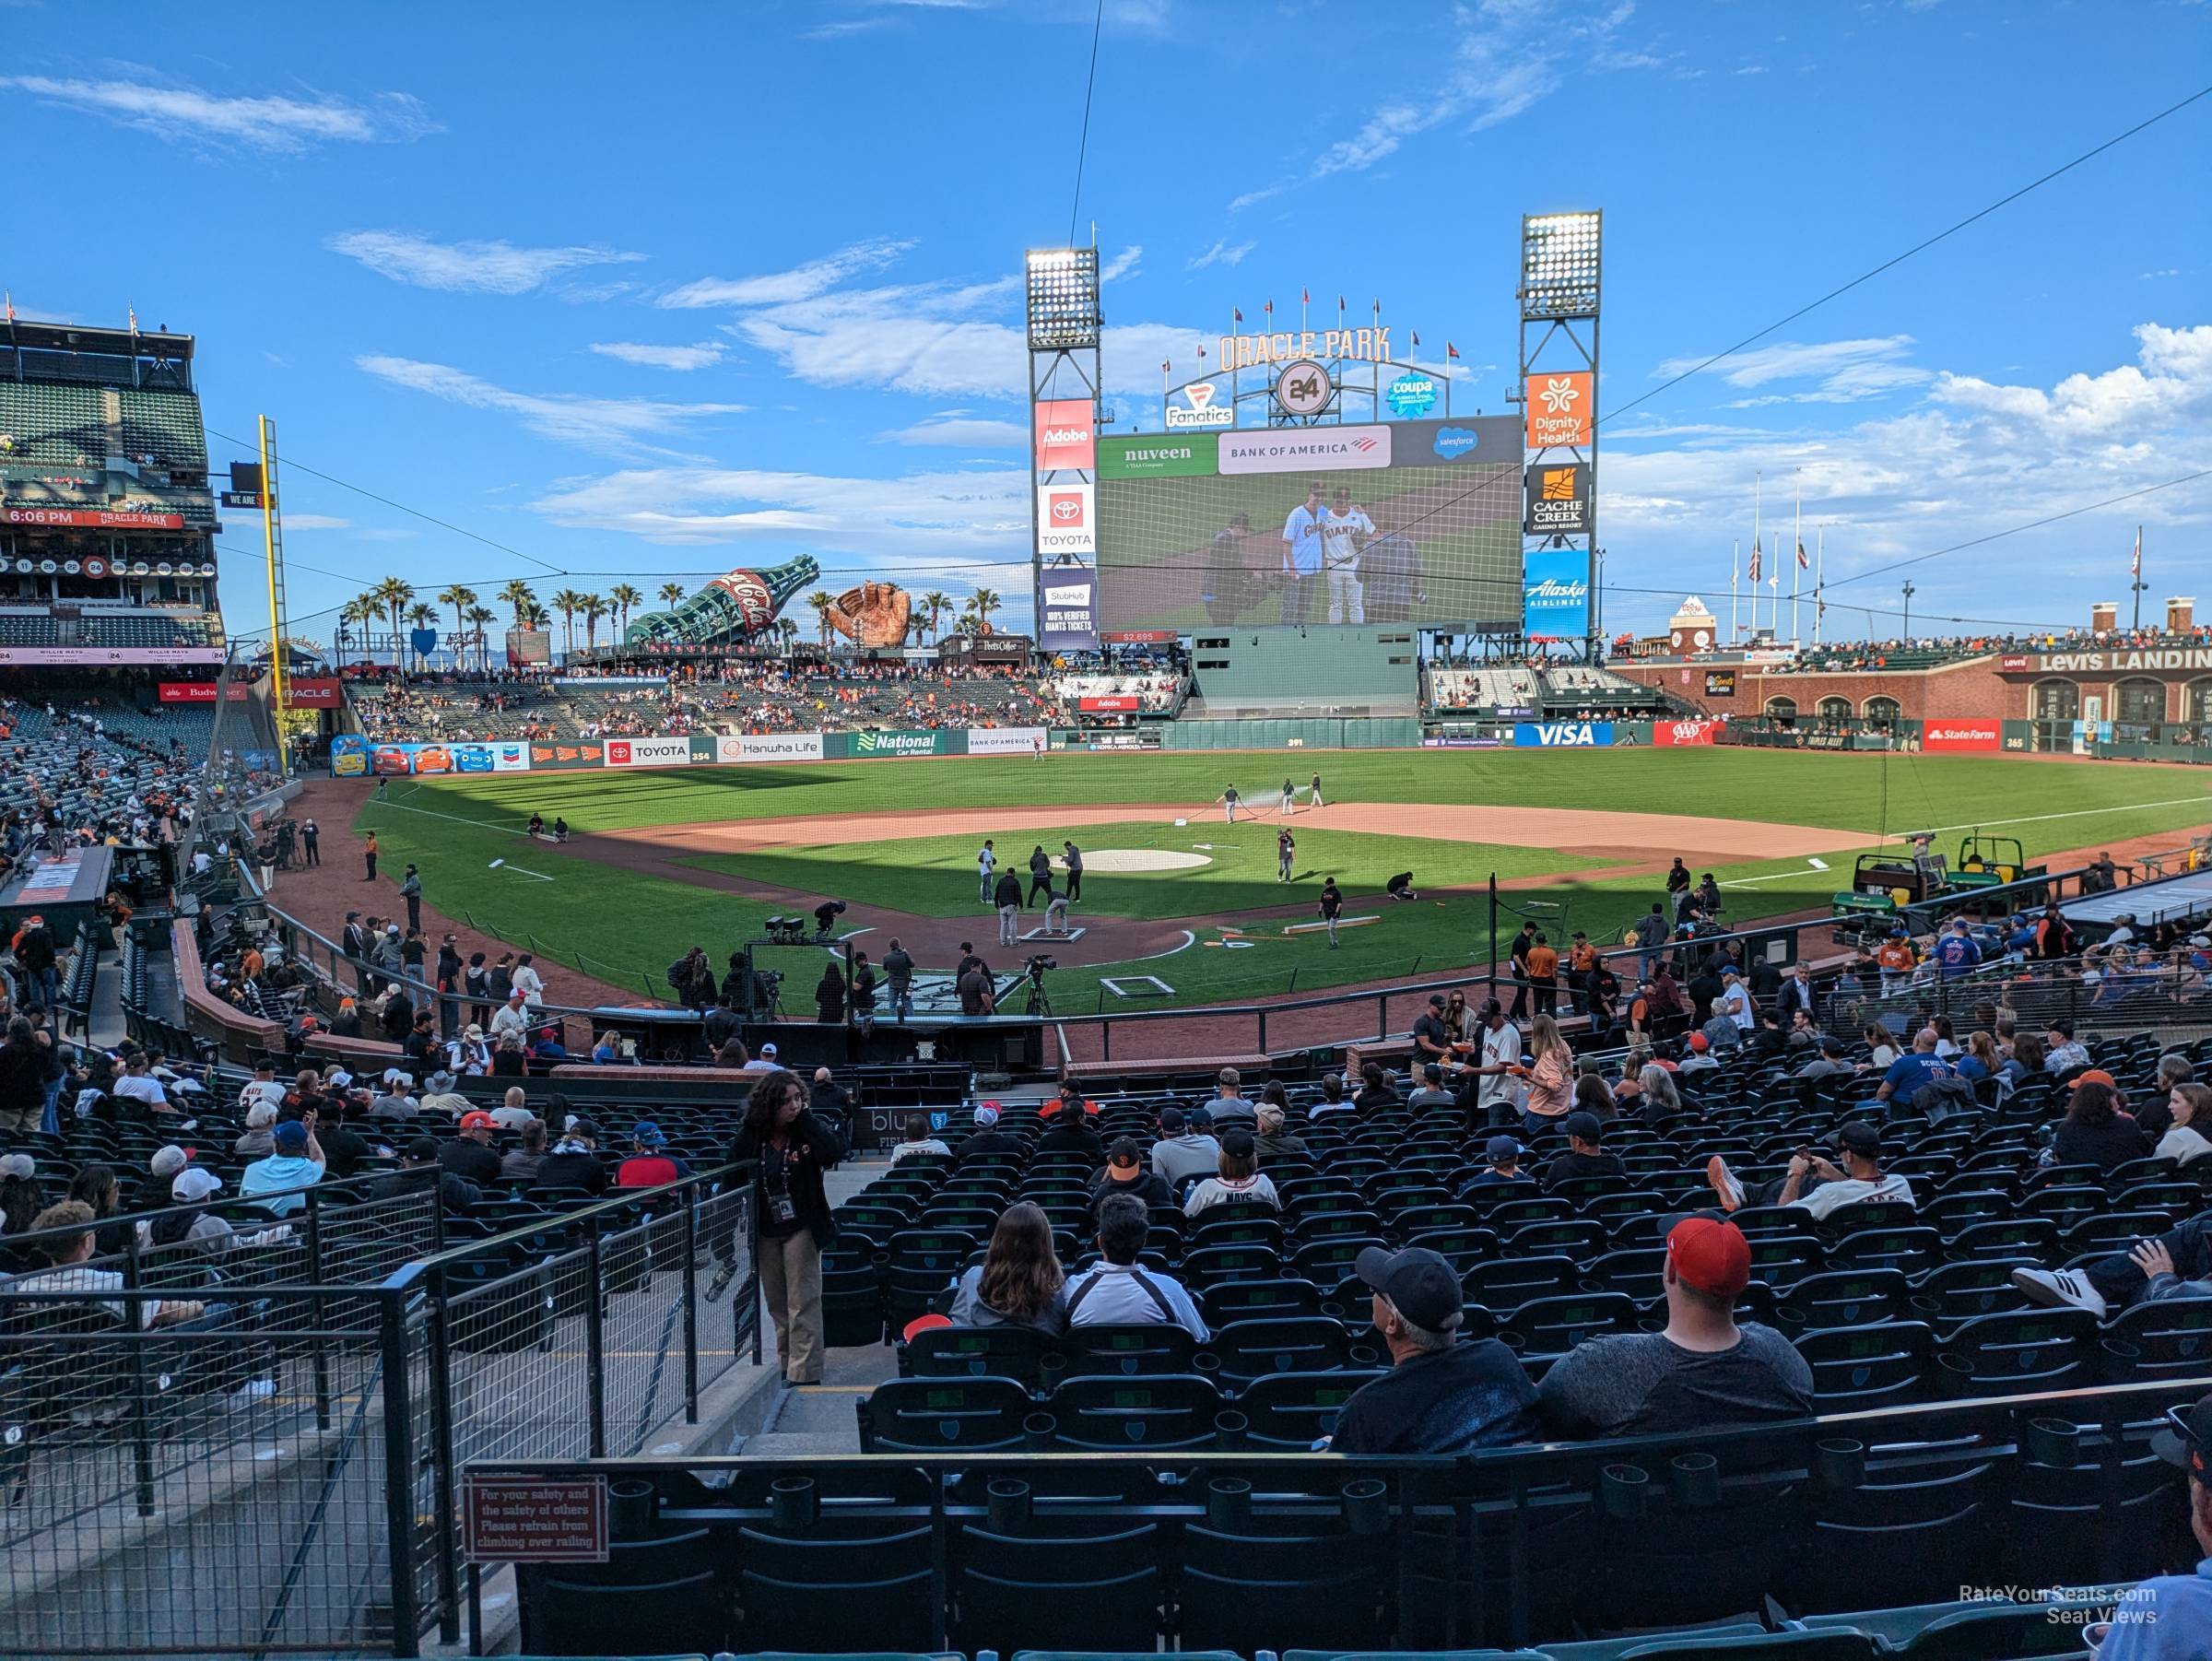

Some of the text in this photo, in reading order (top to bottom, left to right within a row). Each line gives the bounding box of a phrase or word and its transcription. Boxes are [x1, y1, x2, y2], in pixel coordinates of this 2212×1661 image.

[1220, 326, 1392, 371] ORACLE PARK
[1290, 371, 1319, 402] 24
[1394, 382, 1432, 395] coupa
[1170, 408, 1231, 424] Fanatics
[1535, 417, 1582, 432] Dignity
[1043, 429, 1088, 443] Adobe
[1440, 438, 1474, 447] salesforce
[1537, 430, 1580, 443] Health
[1124, 448, 1191, 461] nuveen
[1231, 444, 1348, 457] BANK OF AMERICA
[230, 495, 241, 503] WE
[242, 496, 255, 504] ARE
[1533, 501, 1583, 512] CACHE
[10, 511, 166, 526] 6:06 PM ORACLE PARK
[1535, 512, 1581, 523] CREEK
[1041, 535, 1091, 546] TOYOTA
[1526, 578, 1586, 598] Alaska
[1051, 592, 1084, 600] StubHub
[1047, 611, 1089, 620] 100% VERIFIED
[1045, 621, 1092, 631] GIANTS TICKETS
[335, 628, 406, 652] blue
[190, 688, 241, 696] Budwser
[1534, 725, 1594, 745] VISA
[1674, 724, 1697, 736] AAA
[877, 733, 935, 748] National
[1288, 738, 1303, 747] 391
[2006, 738, 2023, 748] 365
[636, 746, 686, 757] TOYOTA
[743, 742, 818, 754] Hanwha Life
[692, 752, 710, 760] 354
[1946, 949, 1964, 963] 27
[872, 1110, 908, 1131] blu
[1227, 1192, 1253, 1202] MAYS
[480, 1488, 589, 1502] For your safety and
[482, 1504, 589, 1518] the safety of others
[481, 1520, 589, 1531] Please refrain from
[477, 1536, 594, 1549] climbing over railing
